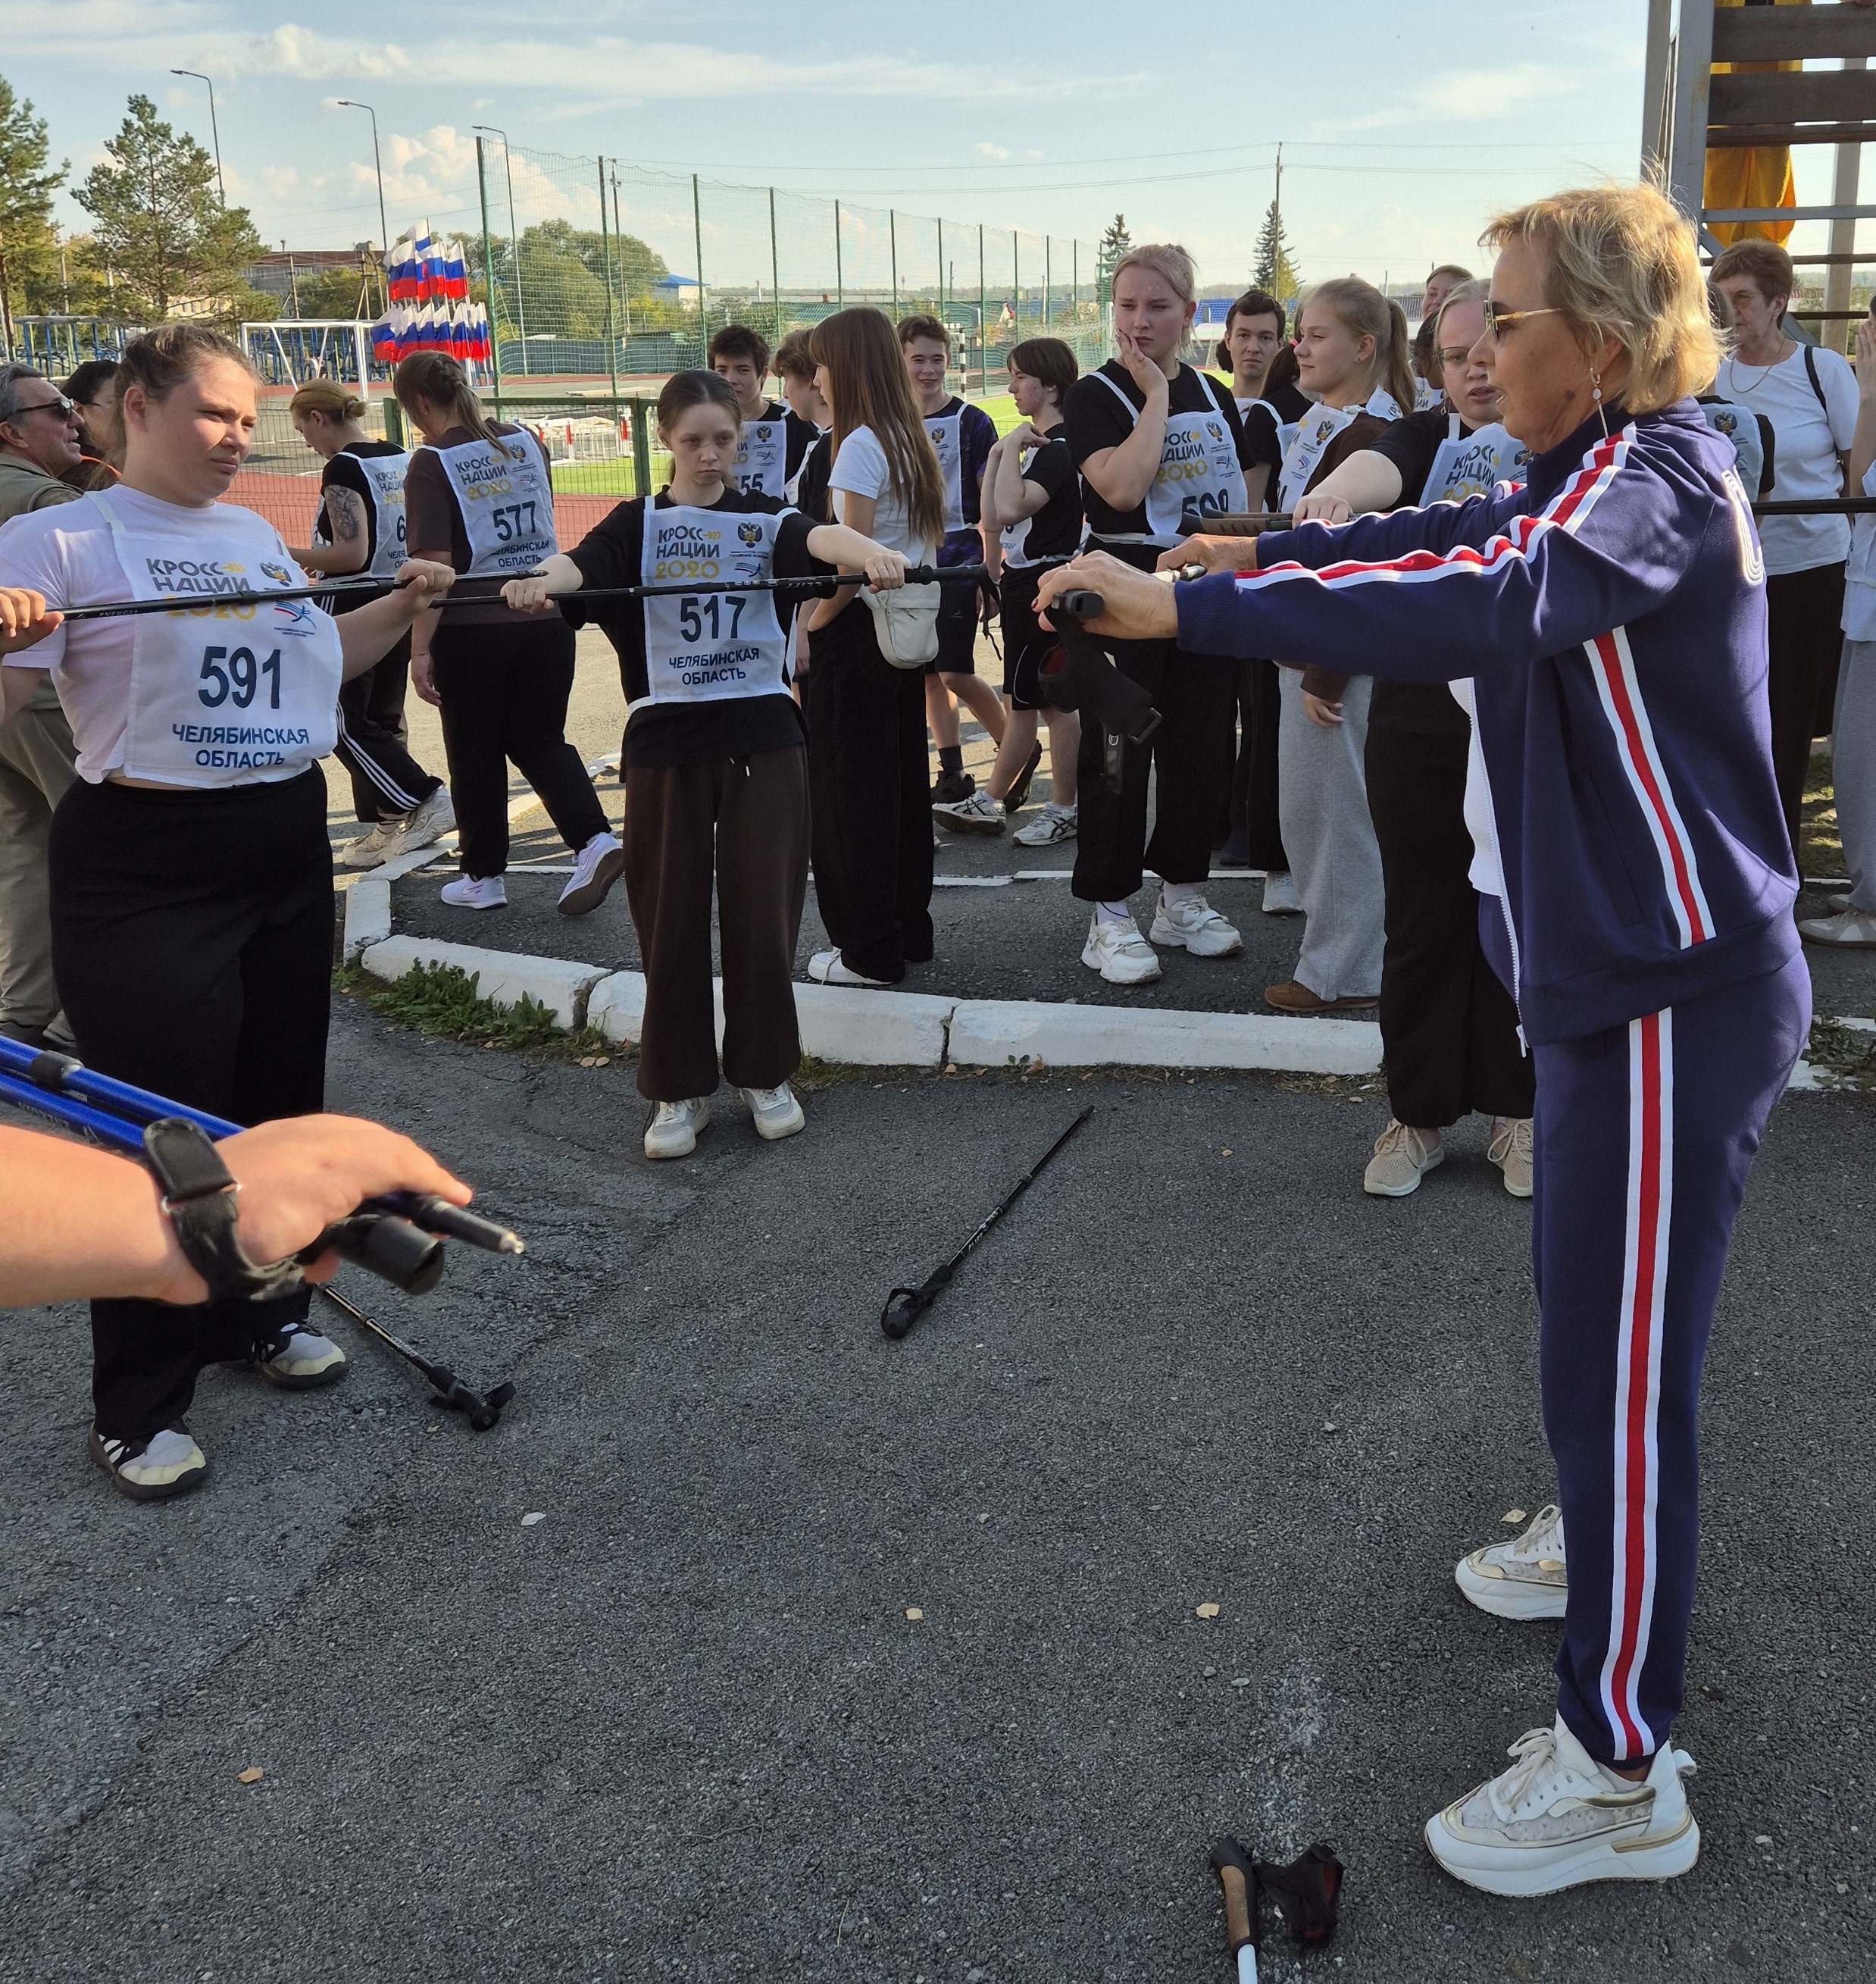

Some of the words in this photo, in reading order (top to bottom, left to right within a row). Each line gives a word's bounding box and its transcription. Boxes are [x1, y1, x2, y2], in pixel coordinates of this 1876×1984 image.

[455, 455, 493, 474] КРОСС
[1160, 443, 1205, 465] АЦИИ
[461, 465, 507, 486] НАЦИИ
[467, 478, 512, 502] 2020
[492, 500, 536, 541] 577
[658, 524, 704, 543] КРОСС
[656, 541, 720, 559] НАЦИИ
[145, 558, 224, 577] КРОСС
[498, 554, 542, 568] ОБЛАСТЬ
[654, 559, 720, 580] 2020
[152, 576, 252, 594] НАЦИИ
[680, 595, 746, 643] 517
[669, 647, 760, 669] ЧЕЛЯБИНСКАЯ
[198, 646, 281, 709] 591
[682, 668, 746, 685] ОБЛАСТЬ
[172, 723, 310, 744] ЧЕЛЯБИНСКАЯ
[195, 749, 286, 768] ОБЛАСТЬ
